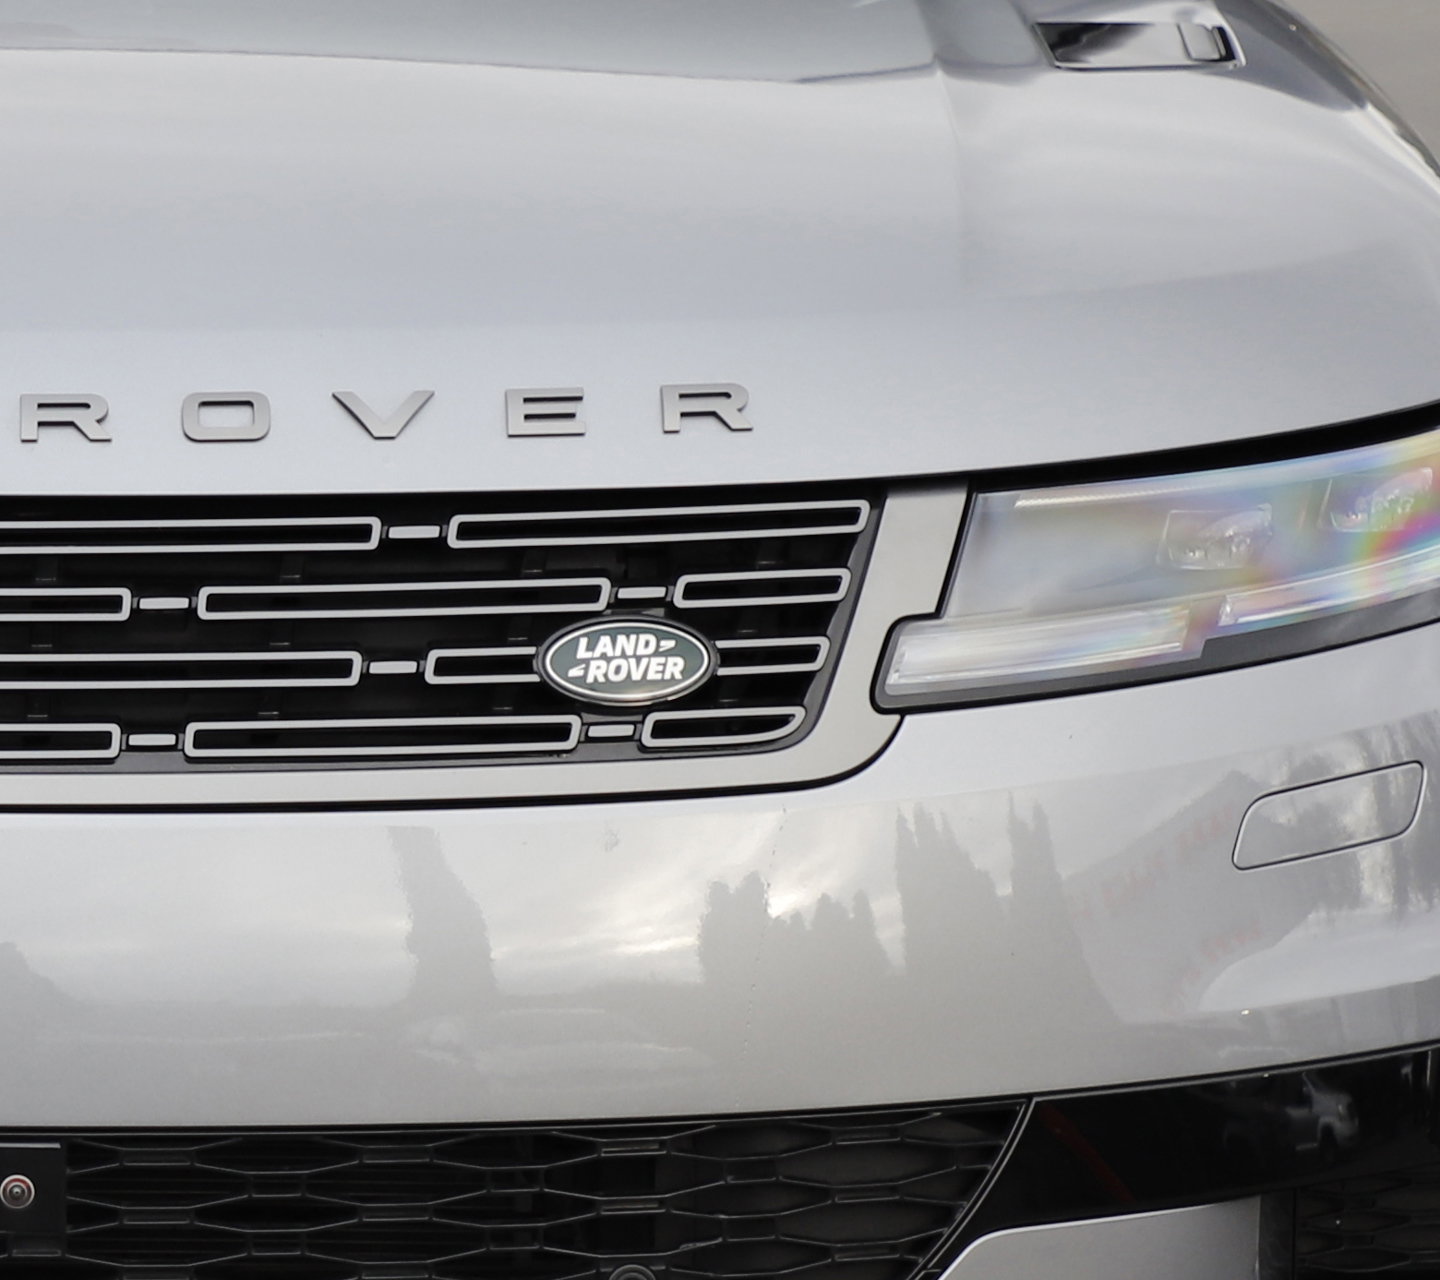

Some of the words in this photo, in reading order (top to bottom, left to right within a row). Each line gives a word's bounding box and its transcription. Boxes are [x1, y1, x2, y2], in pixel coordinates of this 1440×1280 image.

[18, 382, 754, 443] ROVER
[576, 633, 658, 659] LAND
[586, 656, 686, 684] ROVER
